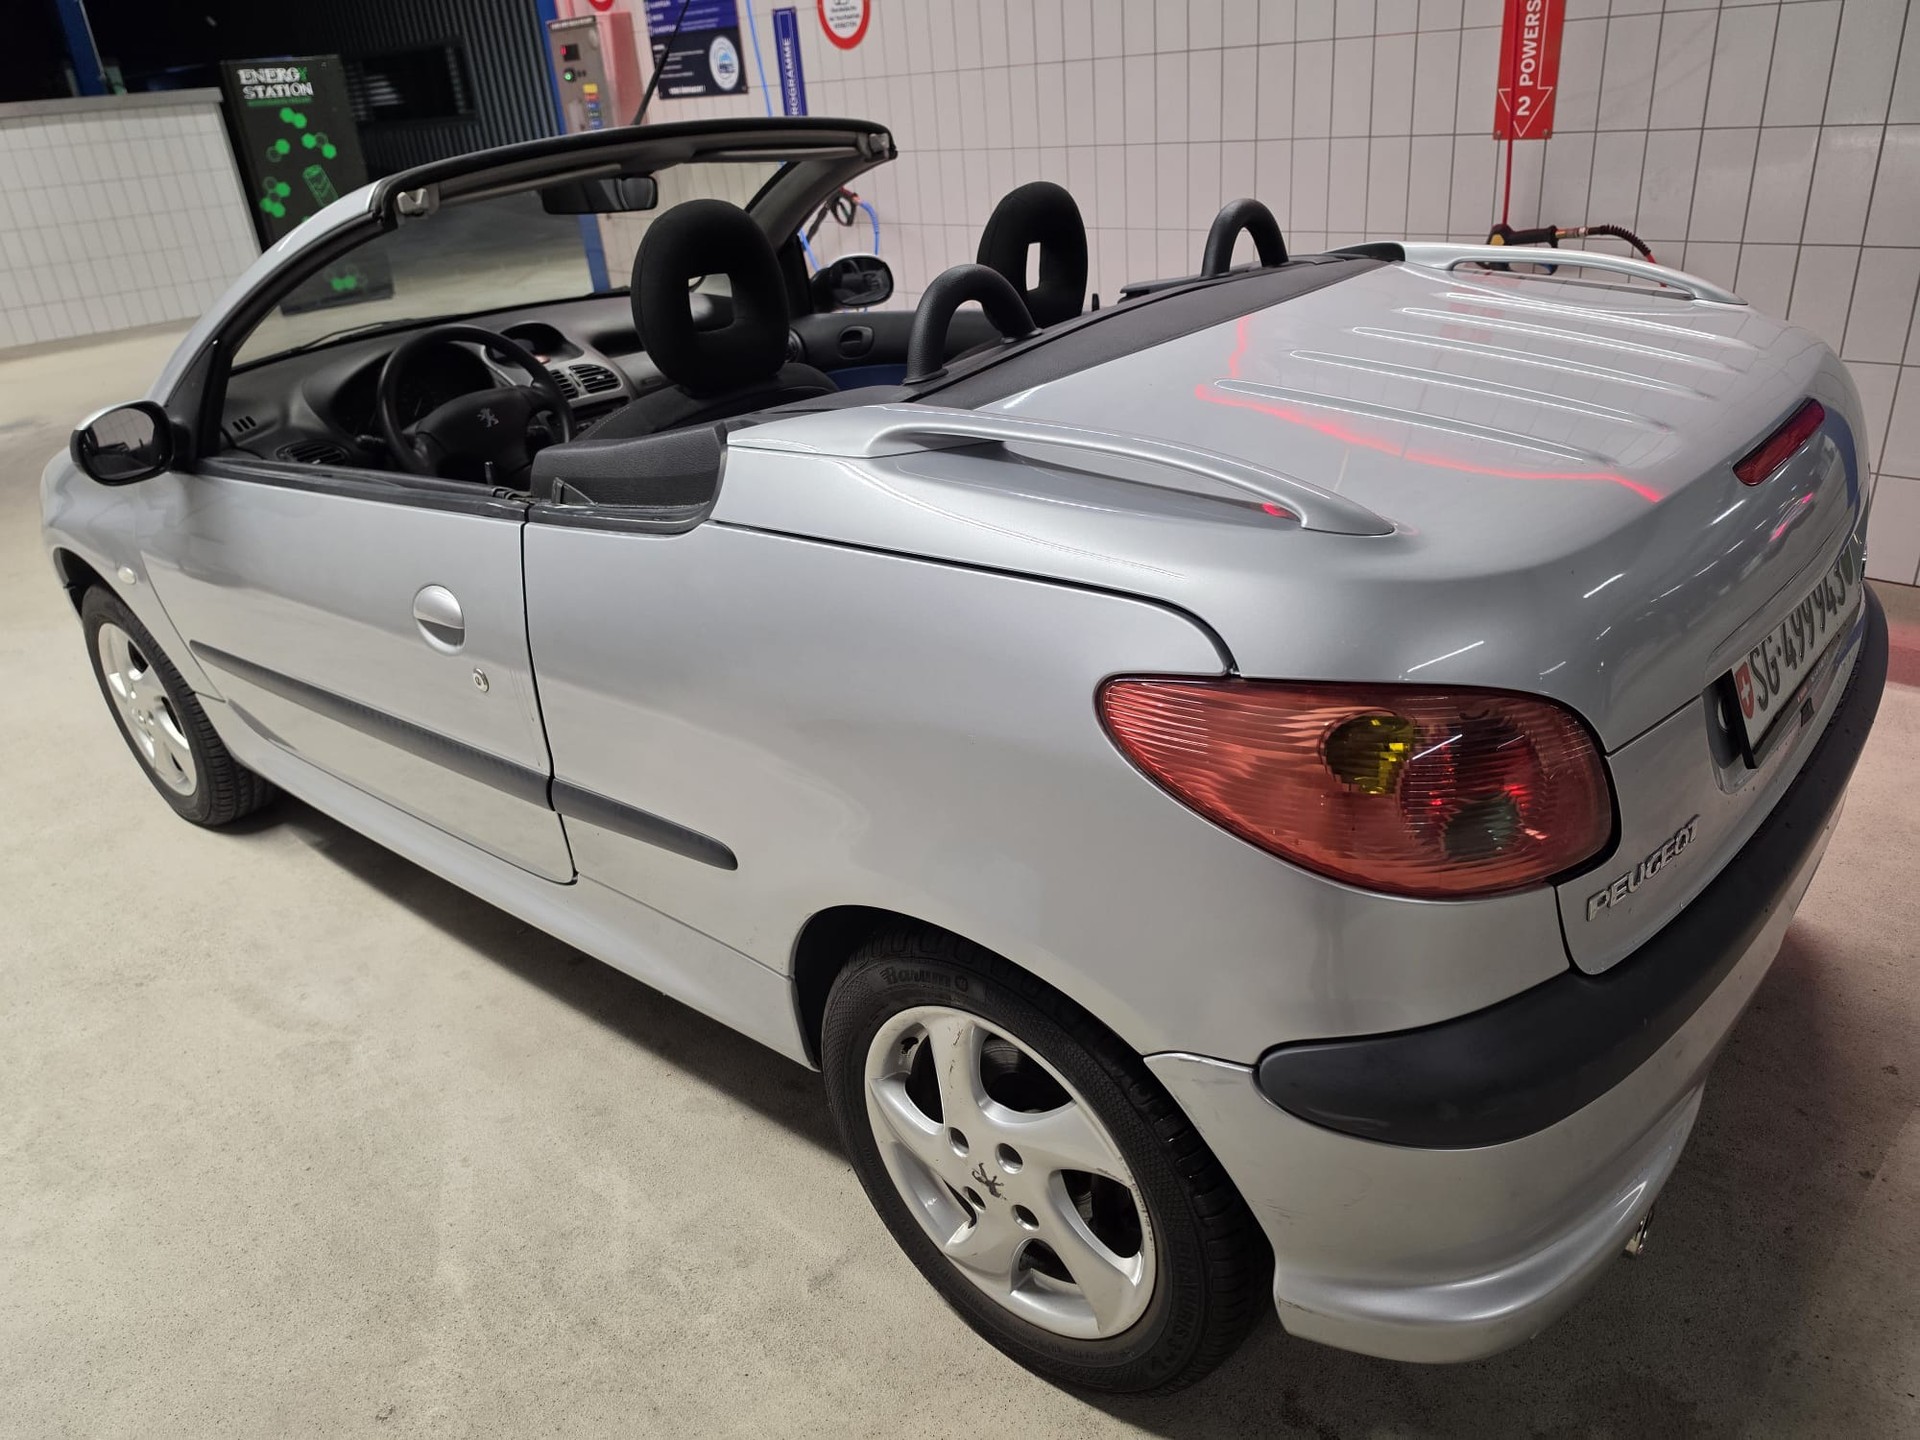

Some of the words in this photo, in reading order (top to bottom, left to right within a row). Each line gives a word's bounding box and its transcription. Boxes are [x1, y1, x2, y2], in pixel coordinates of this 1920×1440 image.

[782, 38, 799, 115] ROGRAMME
[1519, 0, 1542, 86] POWERS
[242, 82, 314, 99] STATION
[1516, 96, 1531, 116] 2
[1587, 813, 1700, 921] PEUGEOT
